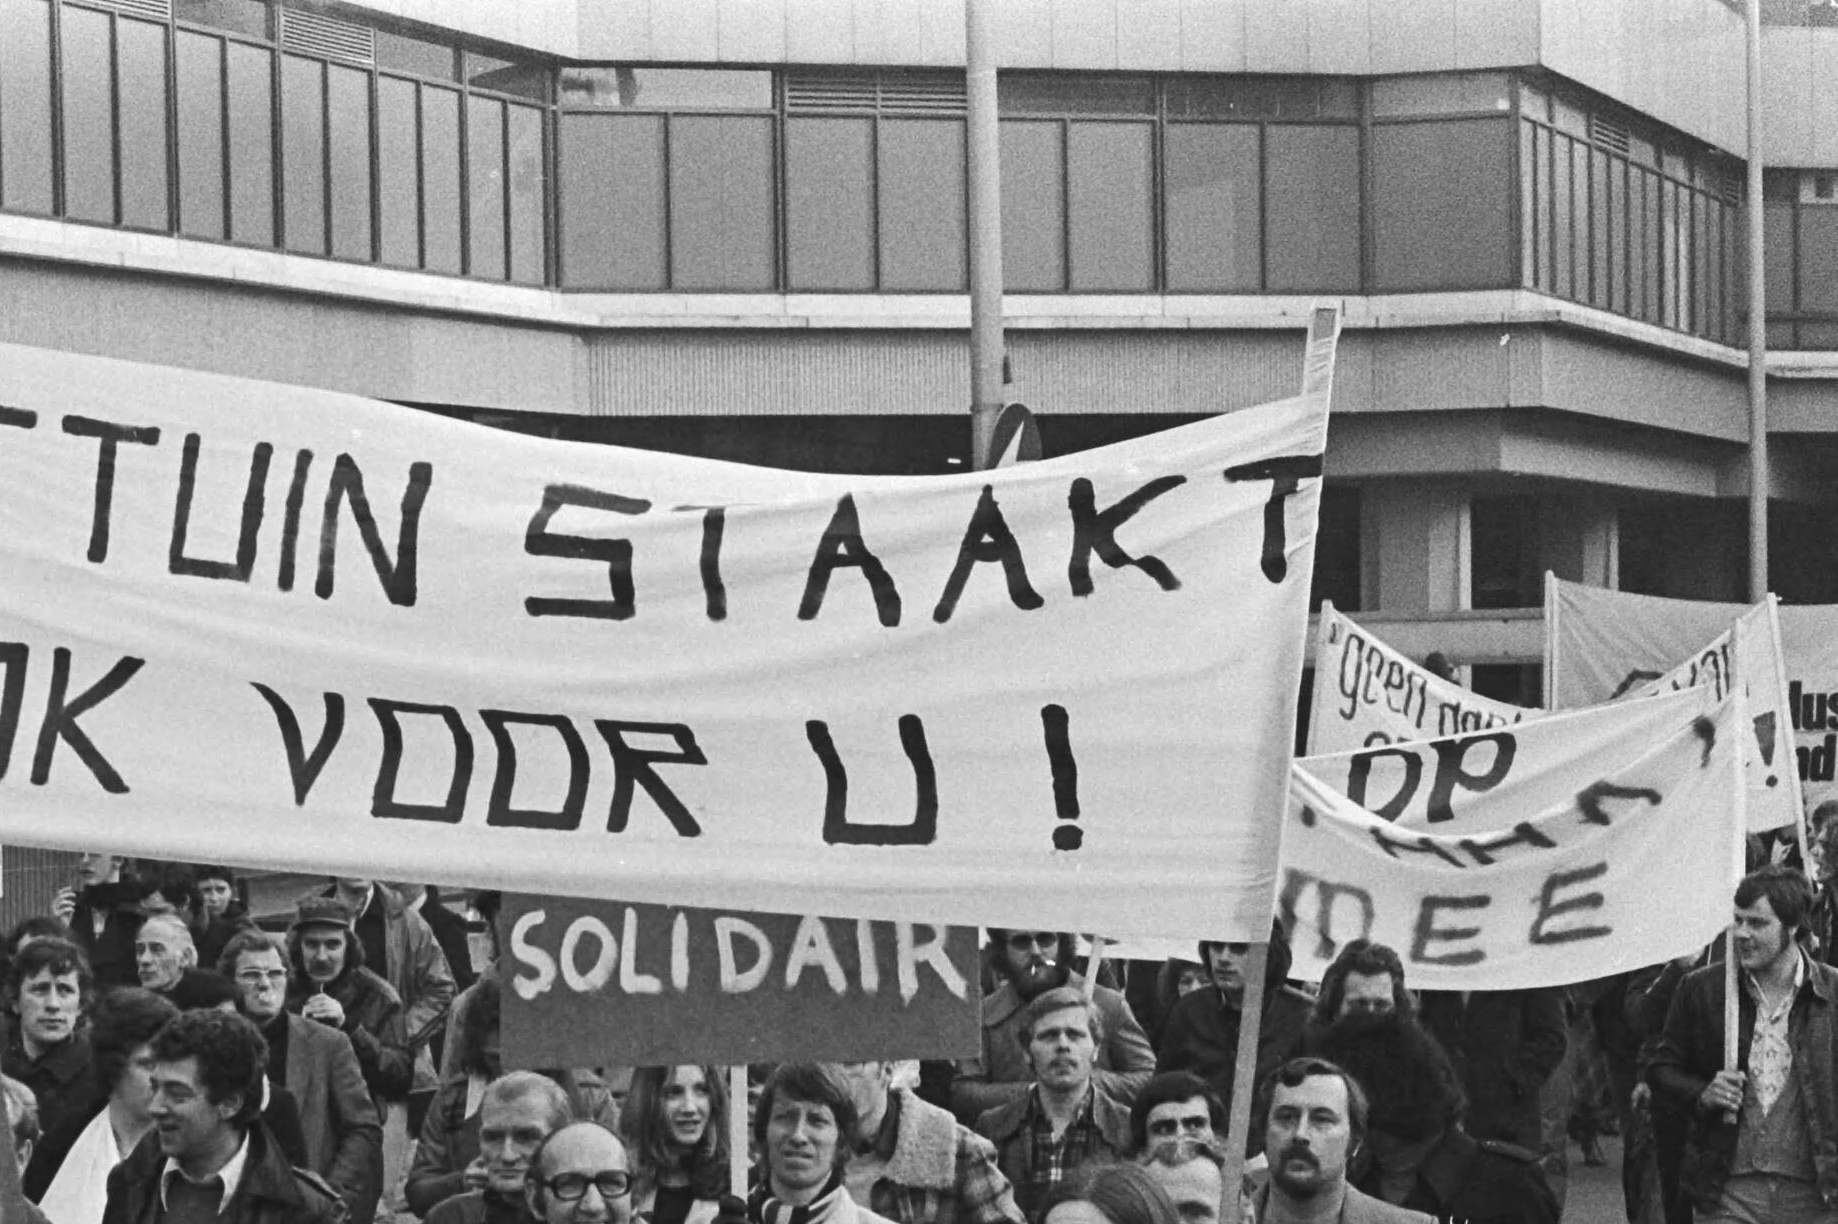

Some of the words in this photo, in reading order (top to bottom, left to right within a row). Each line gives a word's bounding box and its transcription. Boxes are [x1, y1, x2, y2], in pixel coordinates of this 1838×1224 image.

[250, 681, 708, 837] VOOR
[805, 713, 938, 844] U
[507, 906, 967, 1005] SOLIDAIR
